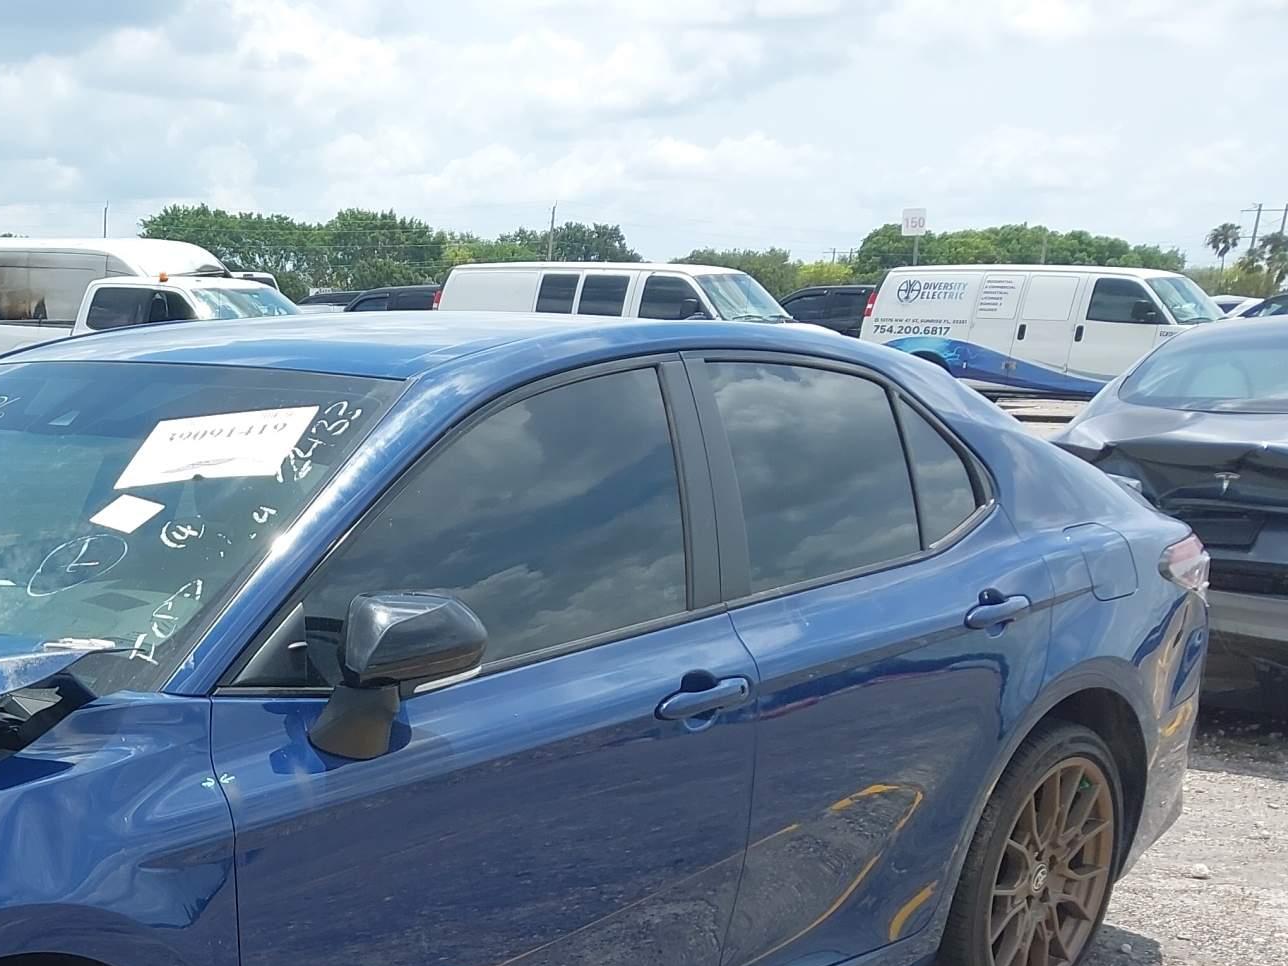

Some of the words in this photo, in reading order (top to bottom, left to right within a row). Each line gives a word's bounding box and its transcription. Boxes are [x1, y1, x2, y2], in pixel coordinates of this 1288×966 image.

[923, 281, 969, 291] DIVERSITY
[920, 291, 965, 300] ELECTRIC
[872, 324, 951, 336] 754.200.6817
